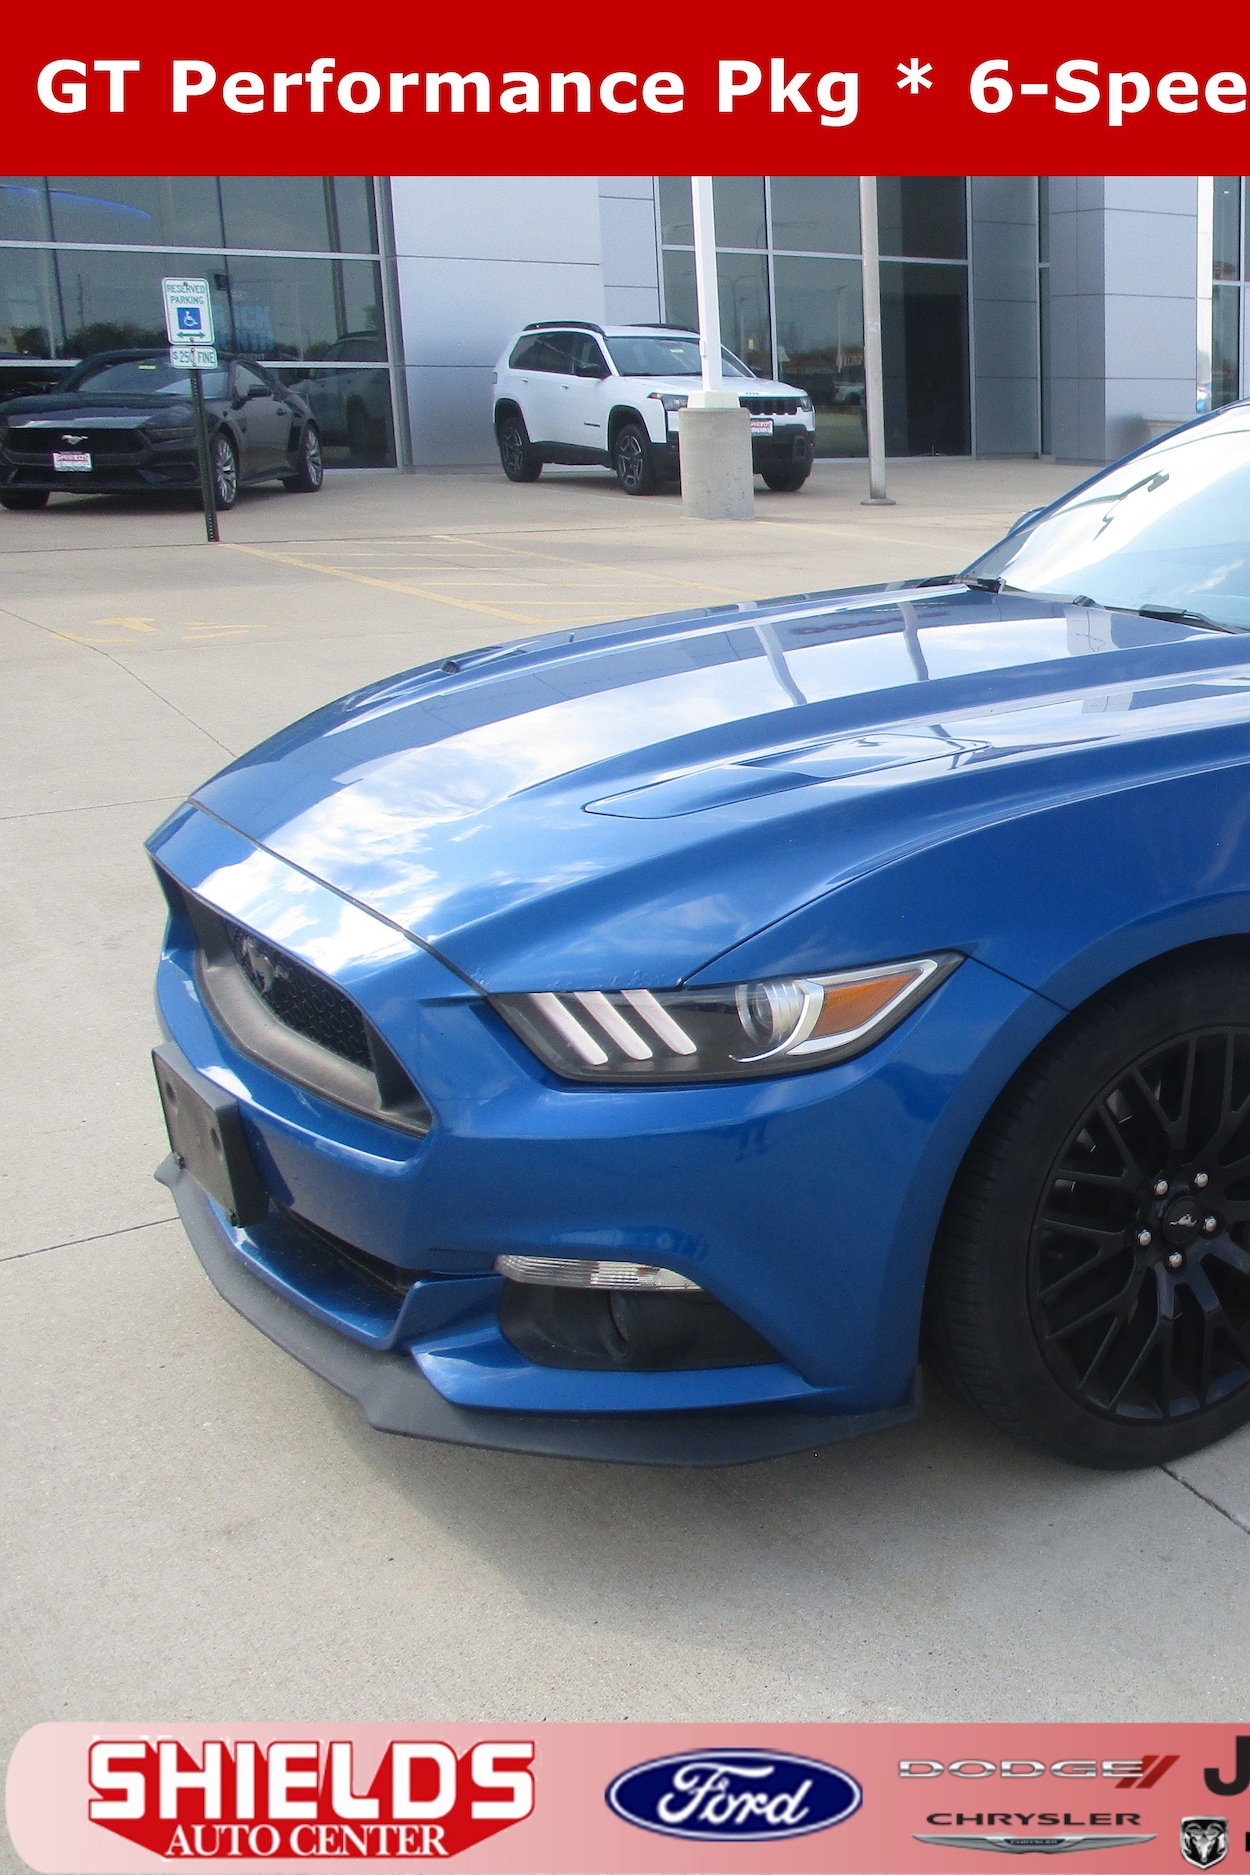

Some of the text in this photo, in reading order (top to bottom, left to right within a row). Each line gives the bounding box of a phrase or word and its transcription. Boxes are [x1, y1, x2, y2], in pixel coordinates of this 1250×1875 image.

[166, 284, 206, 293] RESERVED
[170, 296, 204, 304] PARKING
[197, 352, 216, 363] FINE
